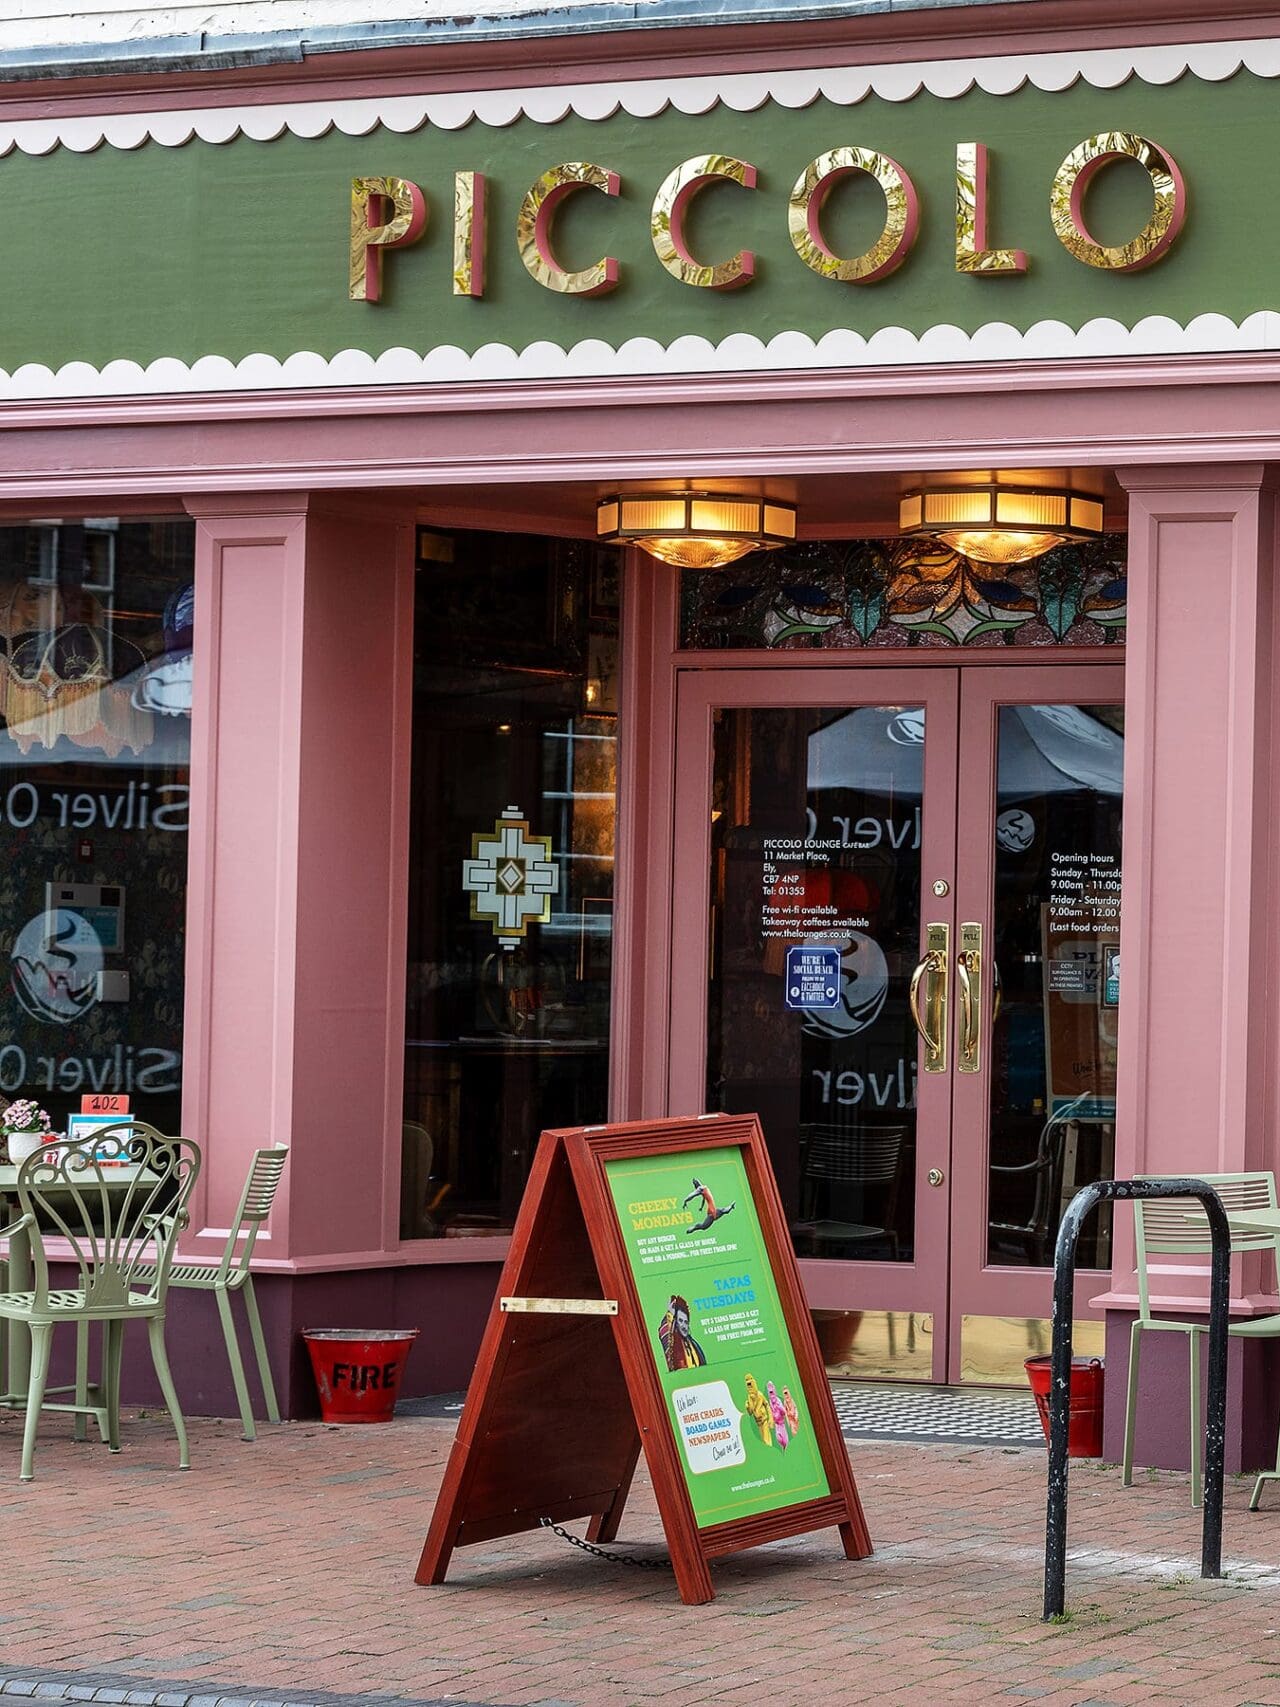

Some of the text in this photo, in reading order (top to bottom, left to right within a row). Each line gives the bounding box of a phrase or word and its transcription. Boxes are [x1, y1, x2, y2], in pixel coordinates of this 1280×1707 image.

[349, 130, 1187, 305] PICCOLO
[763, 840, 802, 848] PICCOLO
[804, 840, 840, 848] LOUNGE
[764, 852, 830, 862] 11 Market Place,
[1051, 852, 1114, 864] Opening hours
[763, 862, 776, 873] Ely,
[1050, 868, 1082, 879] Sunday
[1090, 868, 1122, 878] Thursda
[762, 875, 800, 884] CB7 4NP
[762, 886, 805, 895] Tel: 01353
[1050, 880, 1084, 890] 9.00am
[1093, 880, 1122, 892] 11.00p
[1050, 894, 1076, 906] Friday
[1084, 895, 1121, 906] Saturday
[762, 905, 838, 914] Free wi-fi available
[1050, 908, 1083, 917] 9.00am
[1092, 908, 1116, 917] 12.00
[762, 916, 870, 927] Takeaway coffees available
[1050, 922, 1120, 932] (Last food orders
[762, 929, 852, 938] www.thelounges.co.uk
[91, 1096, 120, 1110] 102
[628, 1197, 678, 1215] CHEEKY
[632, 1211, 694, 1232] MONDAYS
[714, 1274, 752, 1291] TAPAS
[693, 1289, 756, 1312] TUESDAYS
[332, 1362, 398, 1392] FIRE
[682, 1407, 724, 1424] HIGH CHAIRS
[685, 1418, 732, 1436] BOARD GAMES
[688, 1430, 731, 1447] NEWSPAPERS
